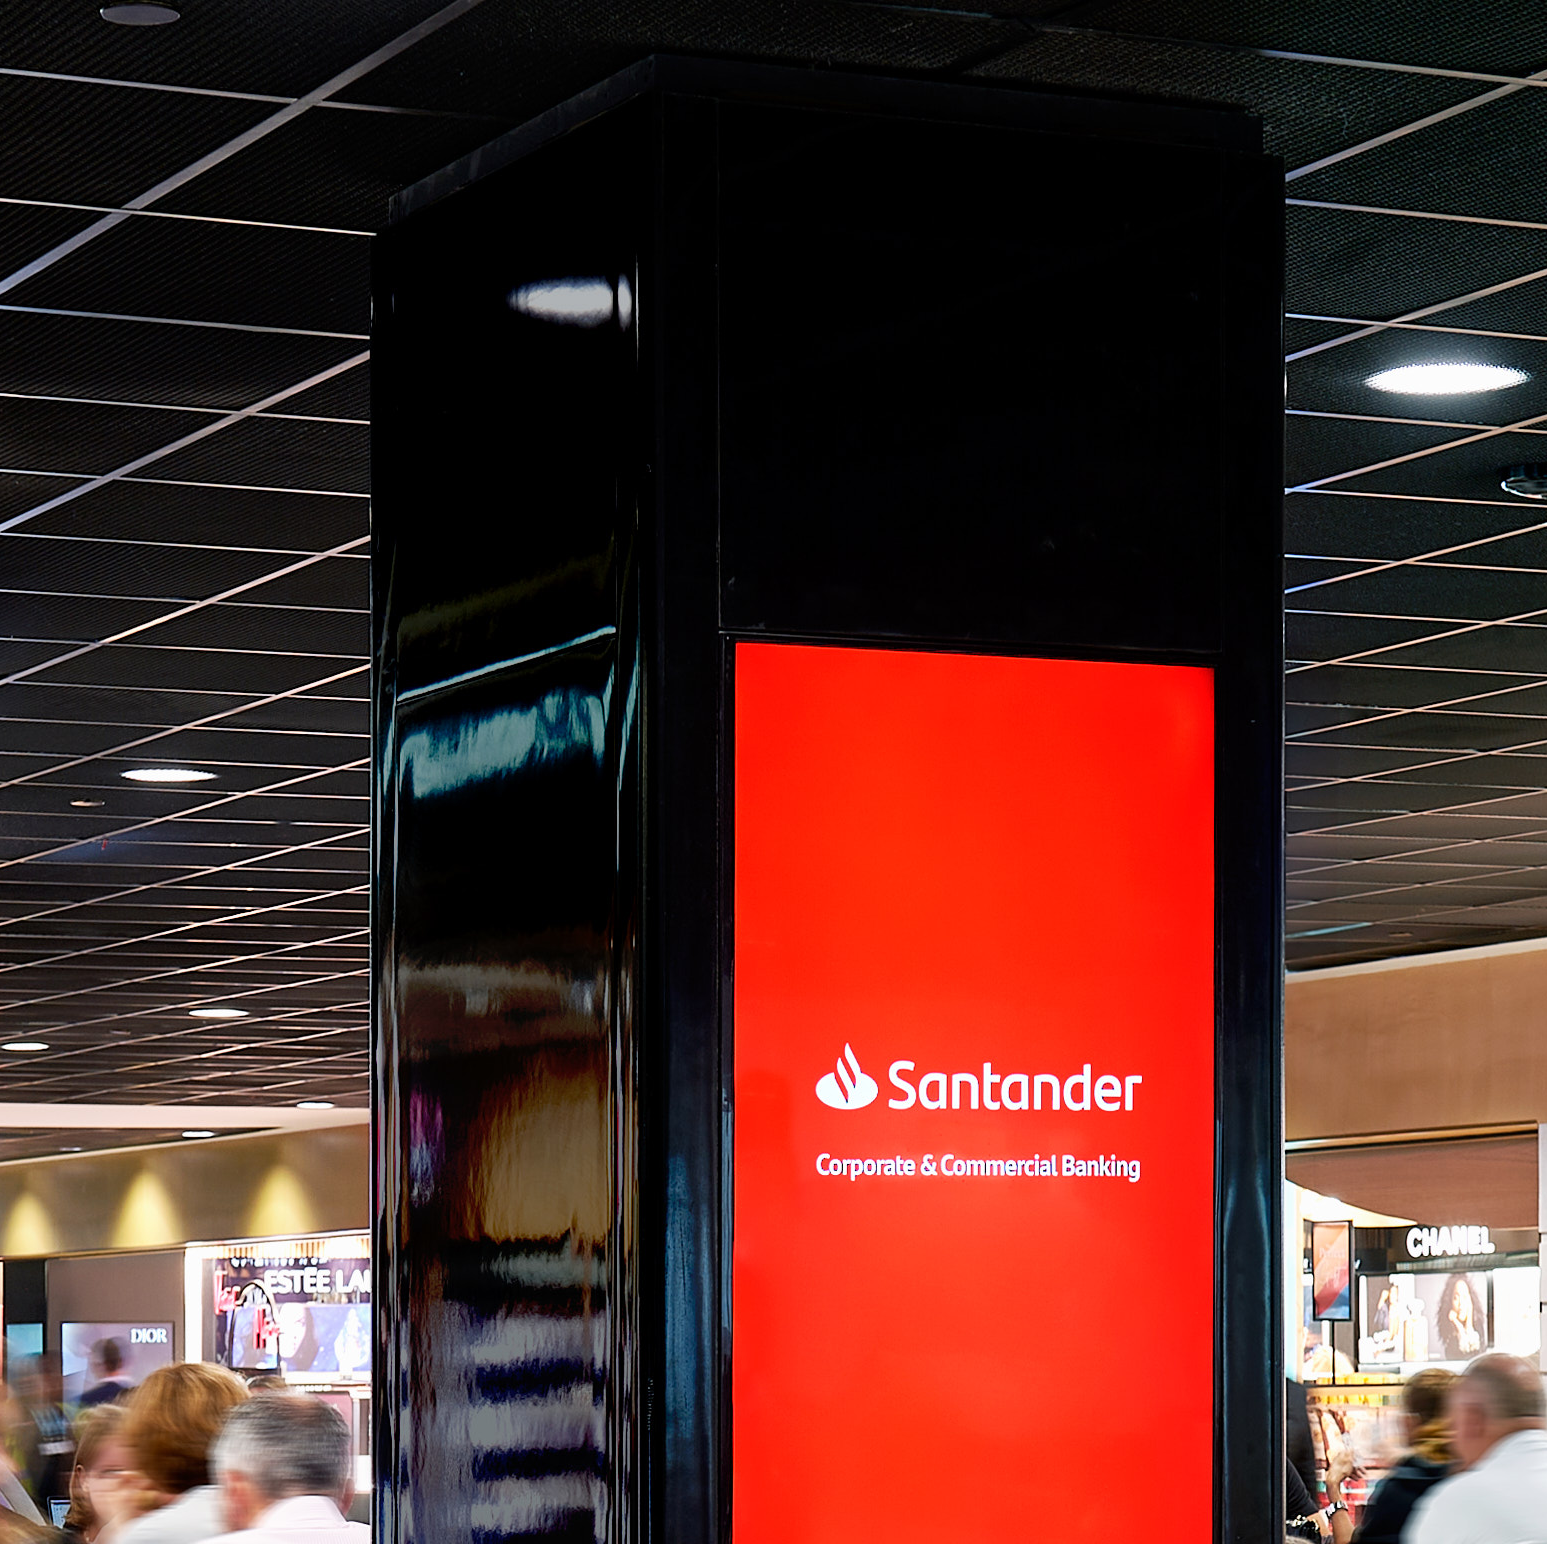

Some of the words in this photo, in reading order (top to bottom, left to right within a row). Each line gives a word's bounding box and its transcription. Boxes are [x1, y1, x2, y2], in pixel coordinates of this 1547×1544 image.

[887, 1060, 1143, 1111] Santander
[815, 1153, 916, 1181] Corporate
[920, 1154, 938, 1177] &
[940, 1154, 1059, 1178] Commercial
[1061, 1154, 1141, 1183] Banking
[1406, 1225, 1496, 1259] CHANEL
[130, 1328, 168, 1344] DIOR
